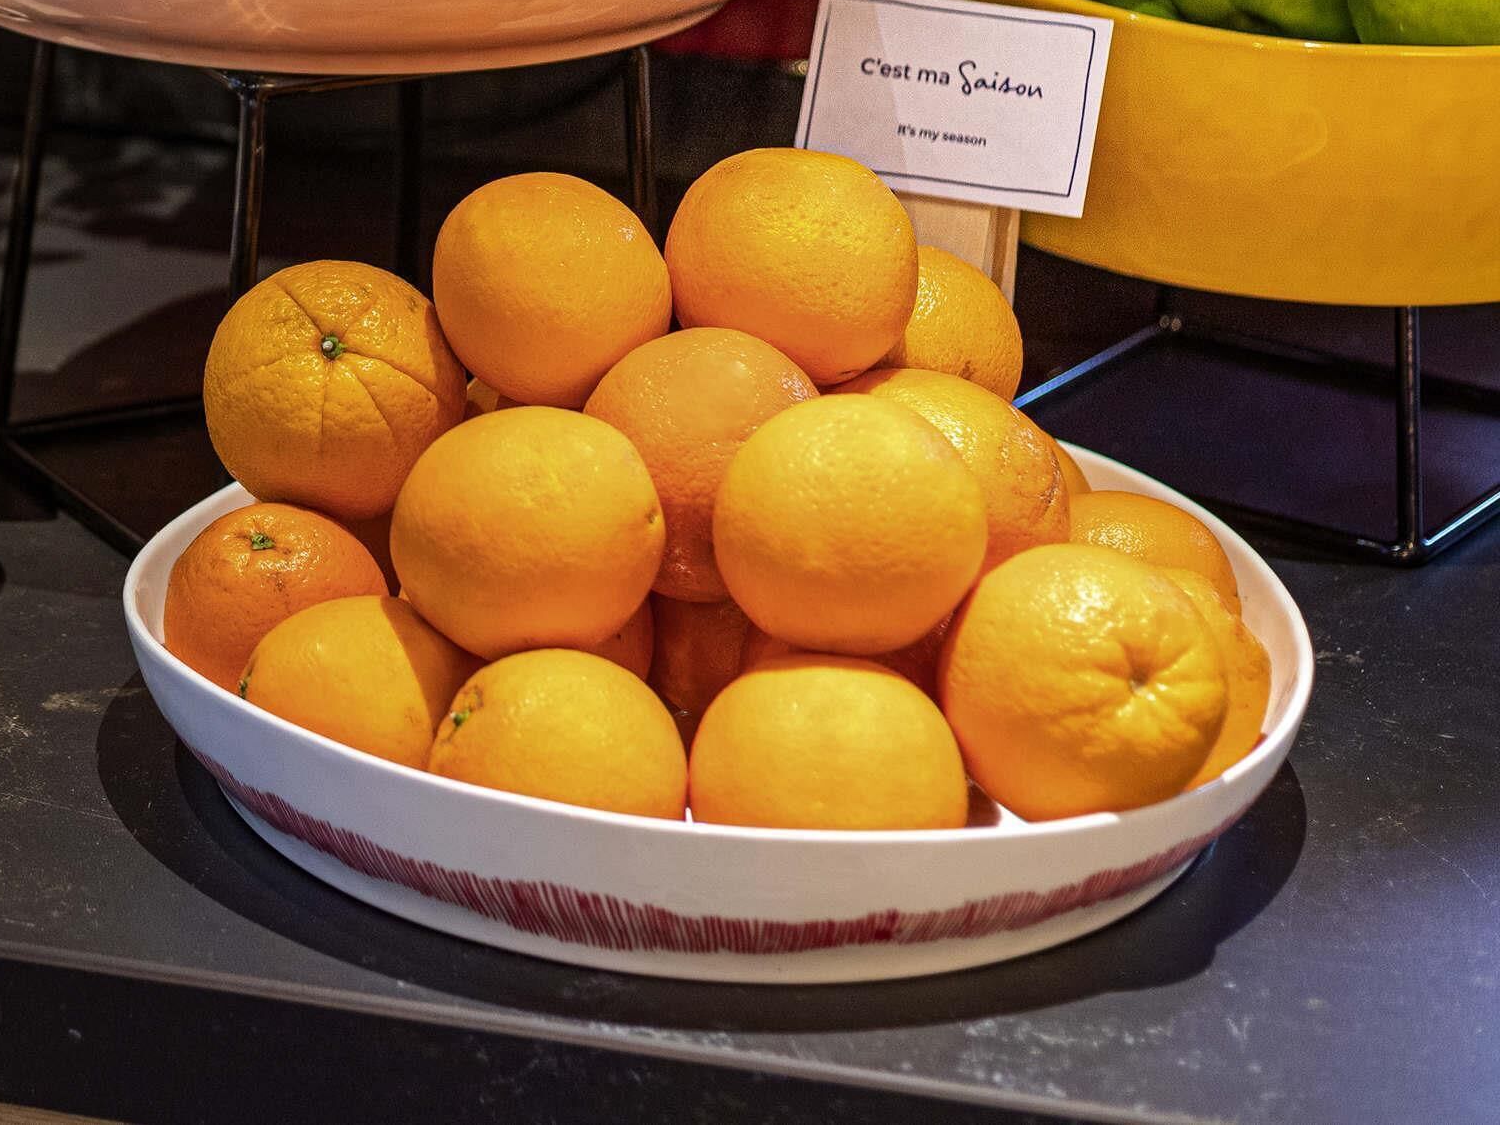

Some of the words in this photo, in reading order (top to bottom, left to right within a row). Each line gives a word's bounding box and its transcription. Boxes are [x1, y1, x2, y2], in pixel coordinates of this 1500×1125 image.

[860, 57, 910, 80] C'est
[917, 69, 950, 86] ma
[957, 60, 1044, 99] Saison
[897, 124, 916, 137] It's
[918, 128, 938, 141] my
[942, 132, 987, 147] season
